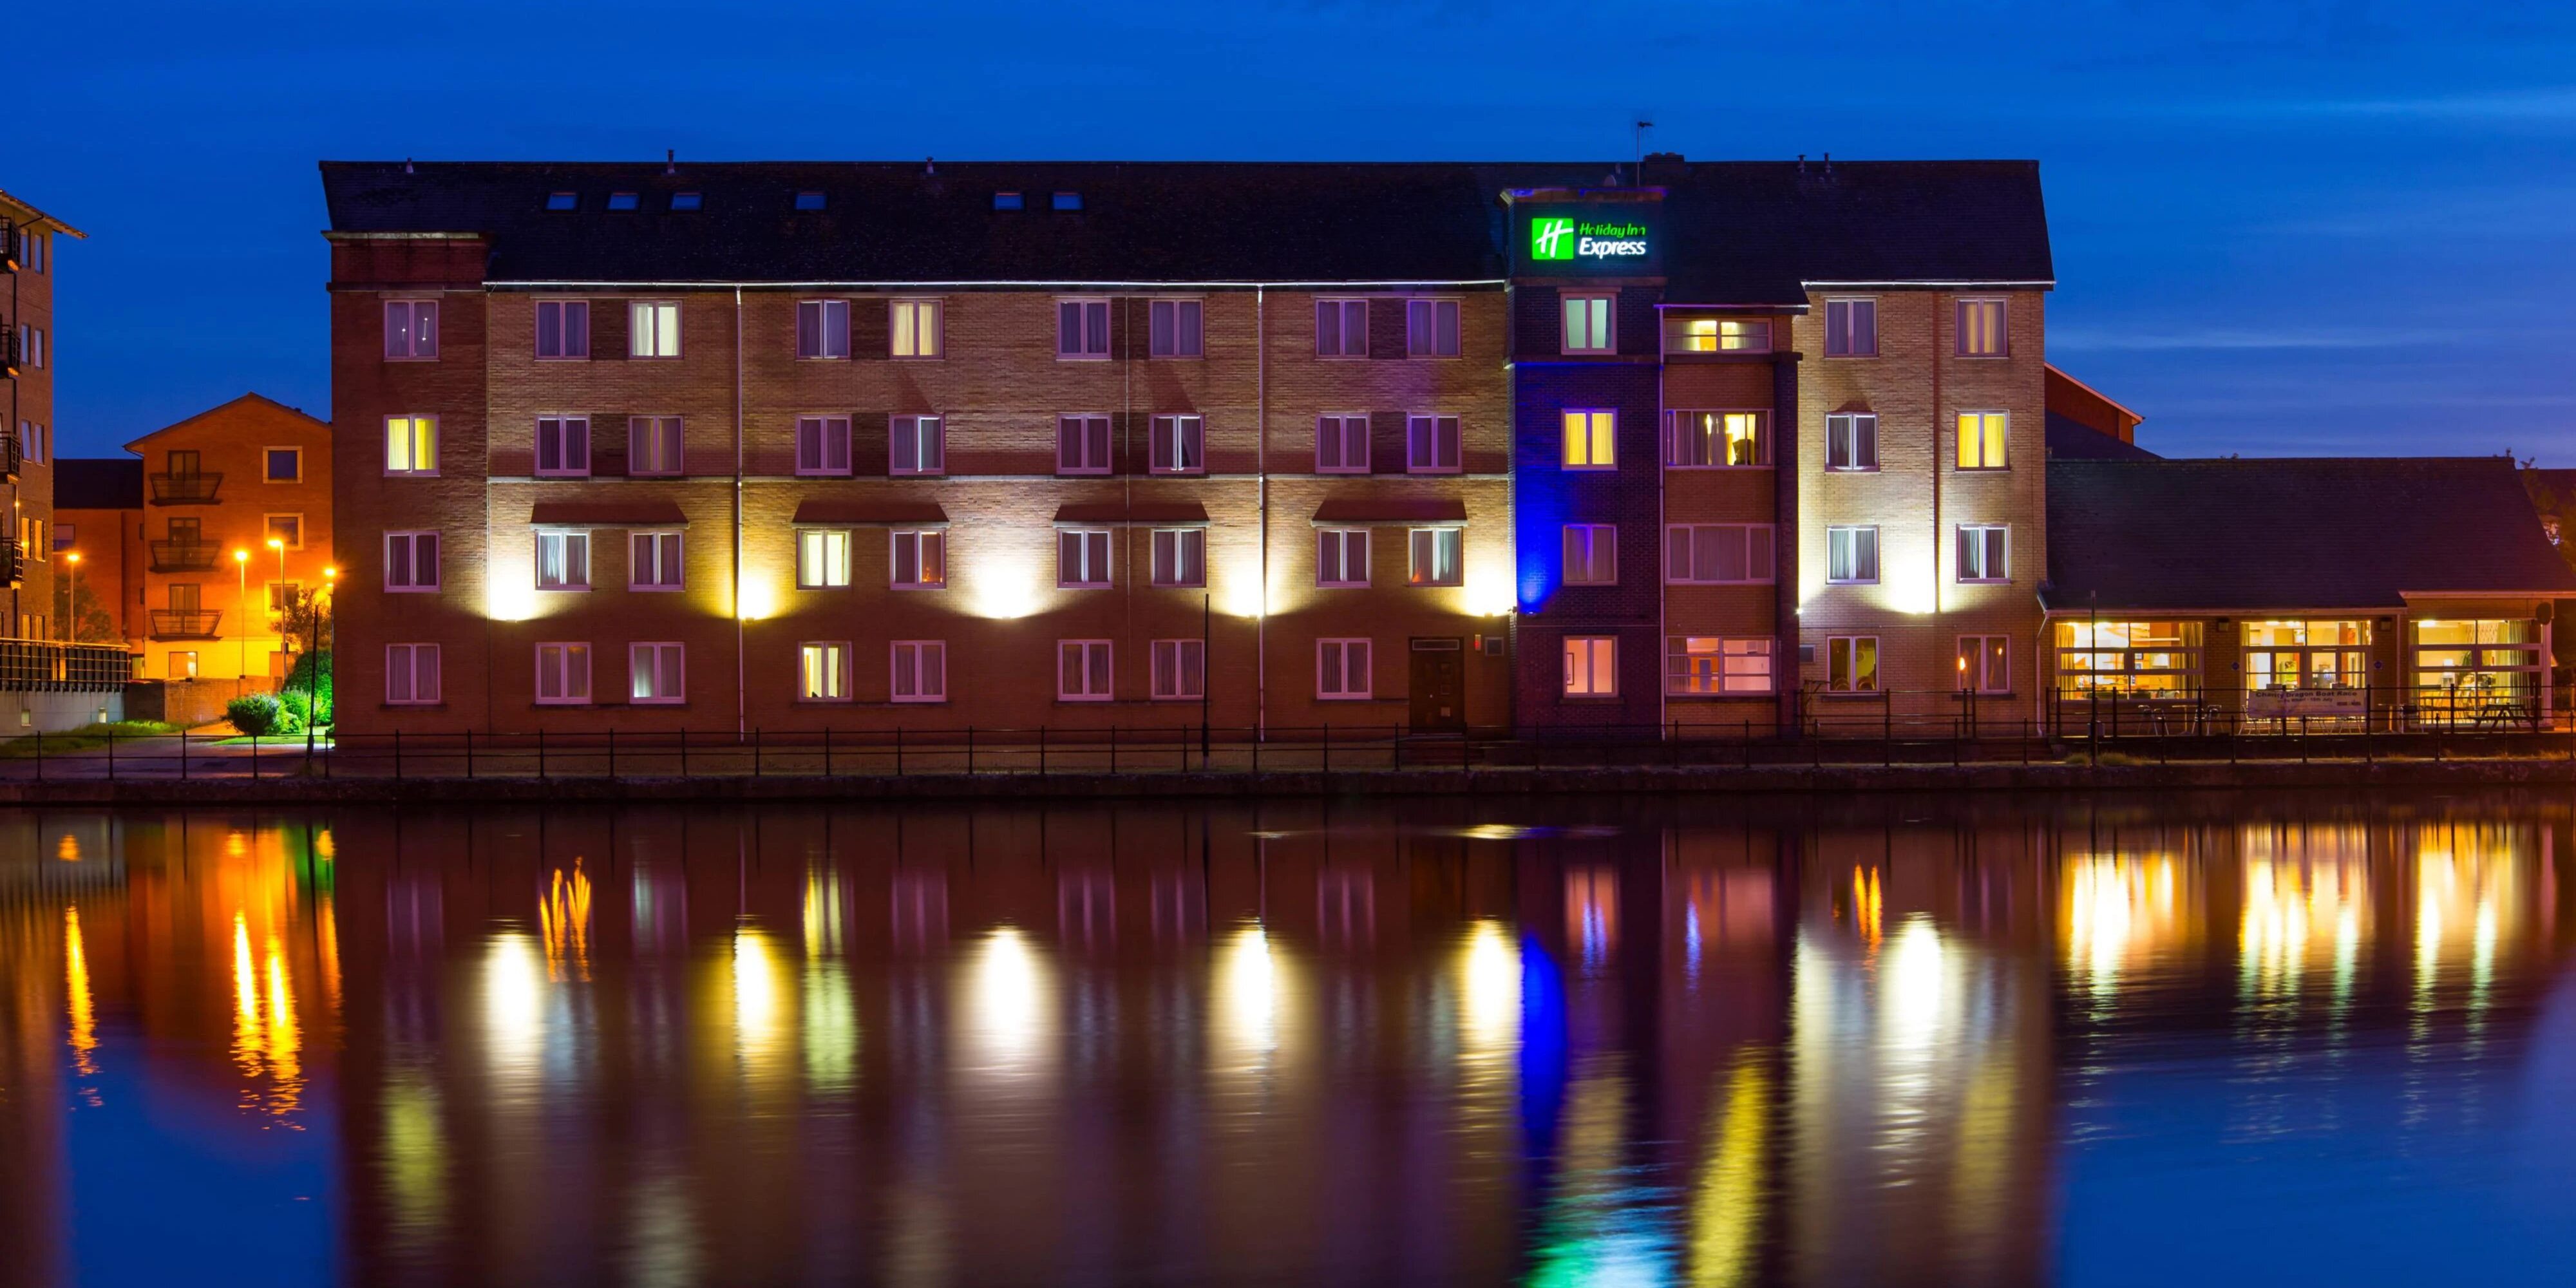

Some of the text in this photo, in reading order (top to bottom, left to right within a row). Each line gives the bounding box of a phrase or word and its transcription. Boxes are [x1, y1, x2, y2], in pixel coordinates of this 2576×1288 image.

[1580, 223, 1645, 238] Holiday Inn
[1579, 238, 1646, 259] Express
